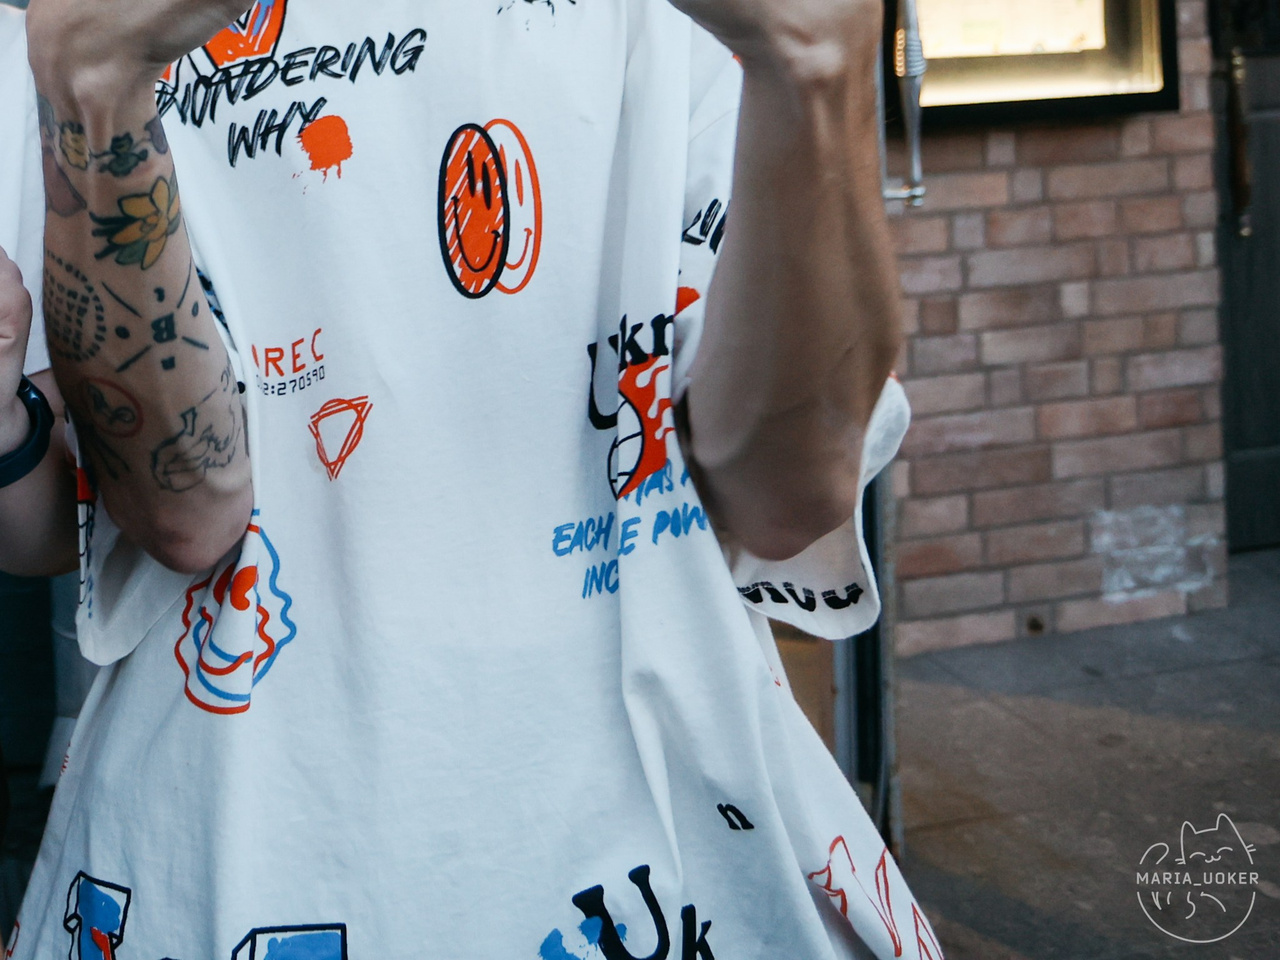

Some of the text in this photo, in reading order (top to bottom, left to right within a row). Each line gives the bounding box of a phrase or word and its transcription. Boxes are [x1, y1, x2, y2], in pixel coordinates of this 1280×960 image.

[228, 97, 328, 168] WHY
[264, 328, 324, 378] REC
[552, 512, 615, 557] EACH
